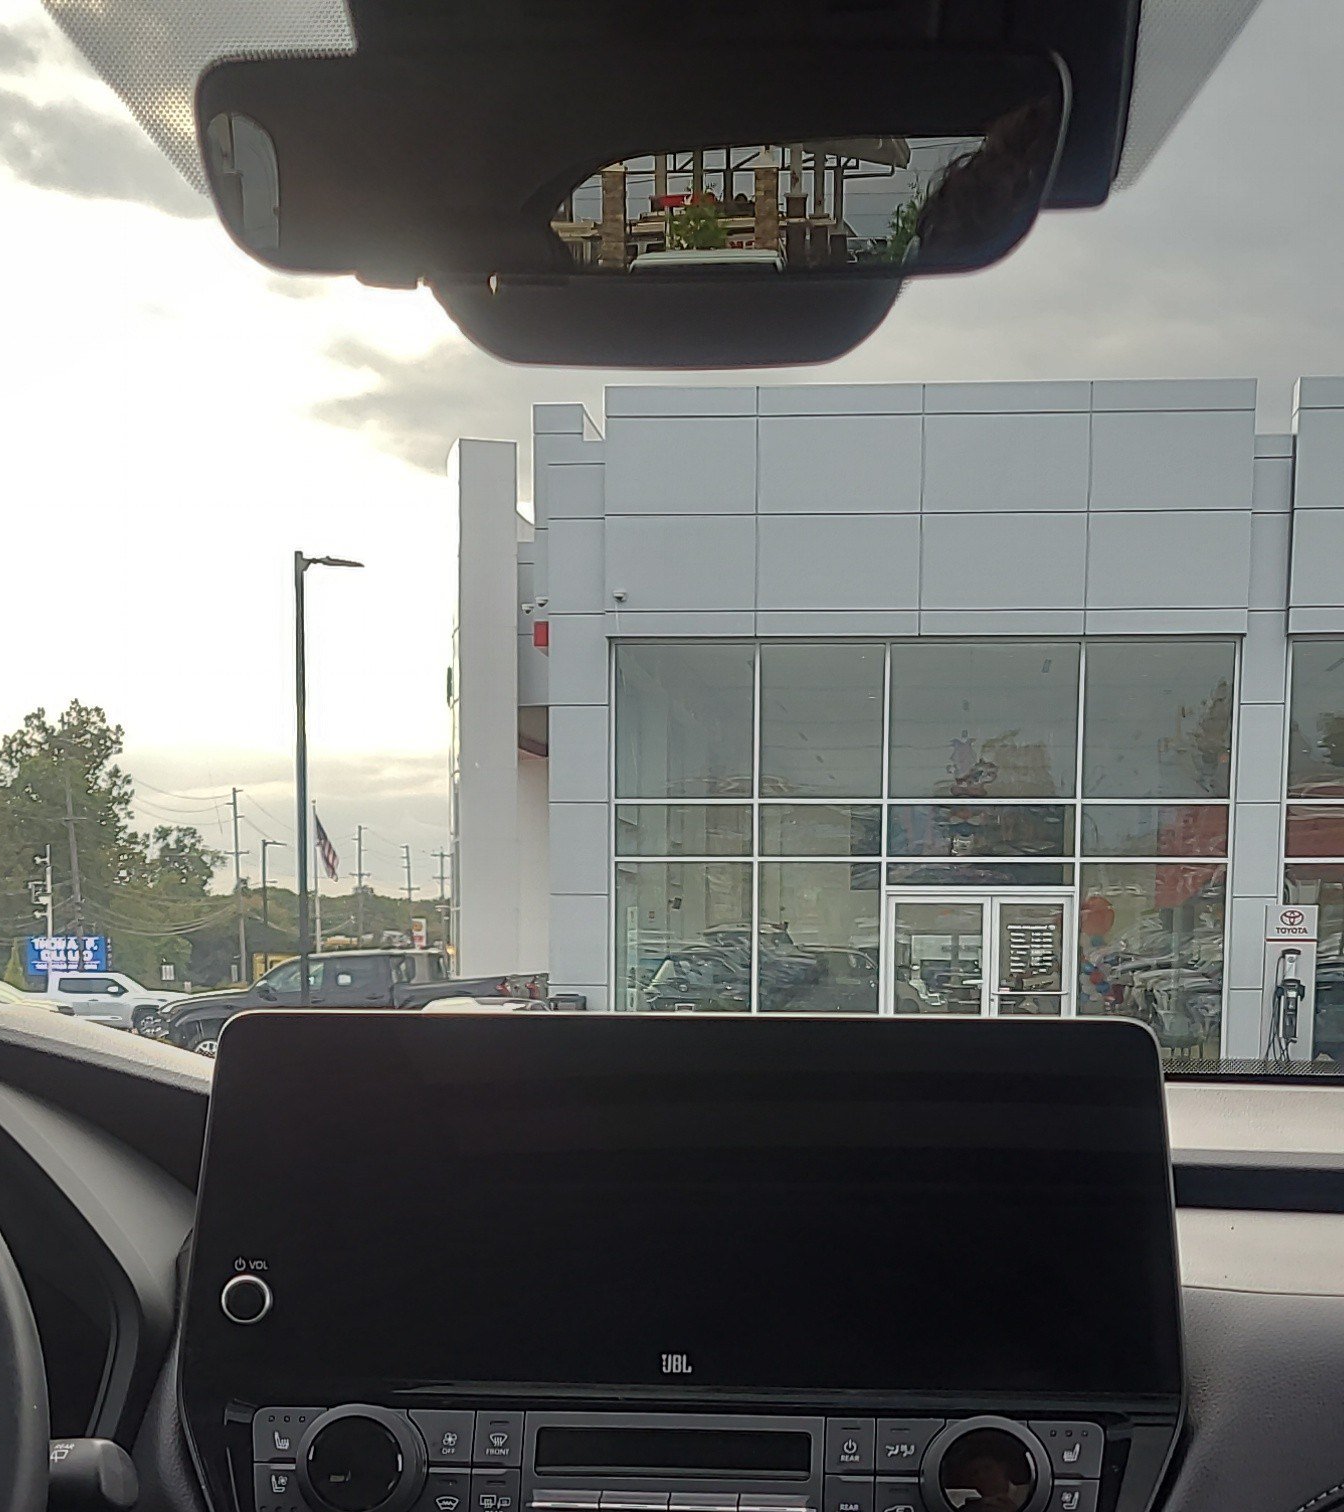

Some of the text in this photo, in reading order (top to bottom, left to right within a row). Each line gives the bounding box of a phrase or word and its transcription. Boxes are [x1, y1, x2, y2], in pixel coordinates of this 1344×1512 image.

[1275, 926, 1308, 934] TOYOTA
[248, 1260, 269, 1270] VOL
[661, 1354, 692, 1373] JBL
[441, 1447, 456, 1455] OFF
[485, 1447, 510, 1456] FRONT
[840, 1454, 860, 1462] REAR
[840, 1503, 859, 1511] REAR
